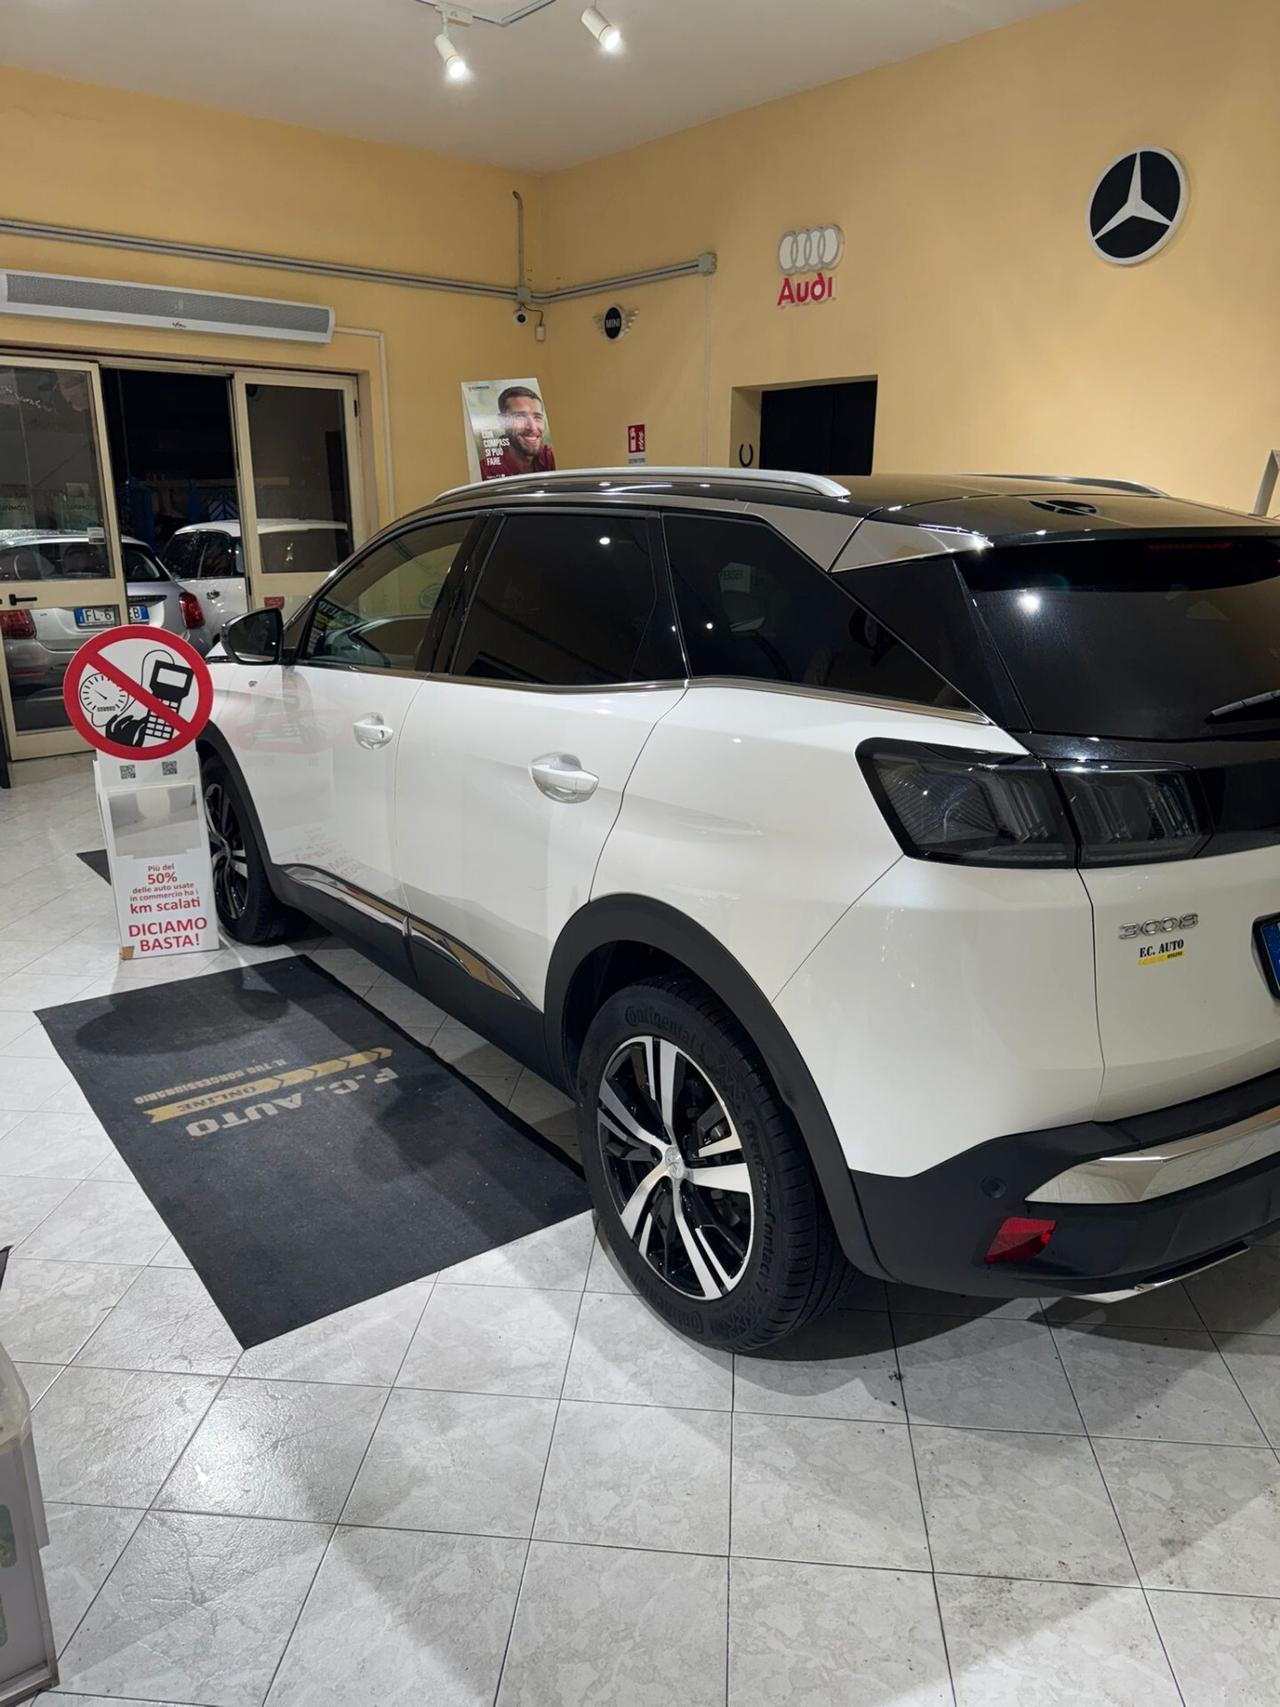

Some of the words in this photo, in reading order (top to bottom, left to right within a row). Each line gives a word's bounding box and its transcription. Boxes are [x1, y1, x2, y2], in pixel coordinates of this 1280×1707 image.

[777, 272, 833, 306] Audi
[605, 318, 621, 329] MINI
[483, 438, 511, 448] COMPASS
[485, 448, 491, 457] SI
[84, 608, 101, 622] FL
[148, 864, 161, 872] Più
[162, 863, 175, 871] del
[147, 872, 178, 885] 50%
[130, 894, 138, 902] in
[139, 891, 183, 902] commercio
[184, 889, 194, 897] ha
[132, 886, 152, 894] delle
[154, 884, 172, 892] auto
[173, 882, 195, 891] usate
[130, 902, 153, 915] km
[156, 896, 201, 912] scalati
[128, 917, 208, 938] DICIAMO
[1119, 912, 1199, 940] 3008
[139, 933, 201, 952] BASTA!
[1158, 938, 1185, 954] AUTO
[177, 1086, 257, 1112] ONLINE
[185, 1092, 303, 1137] AUTO
